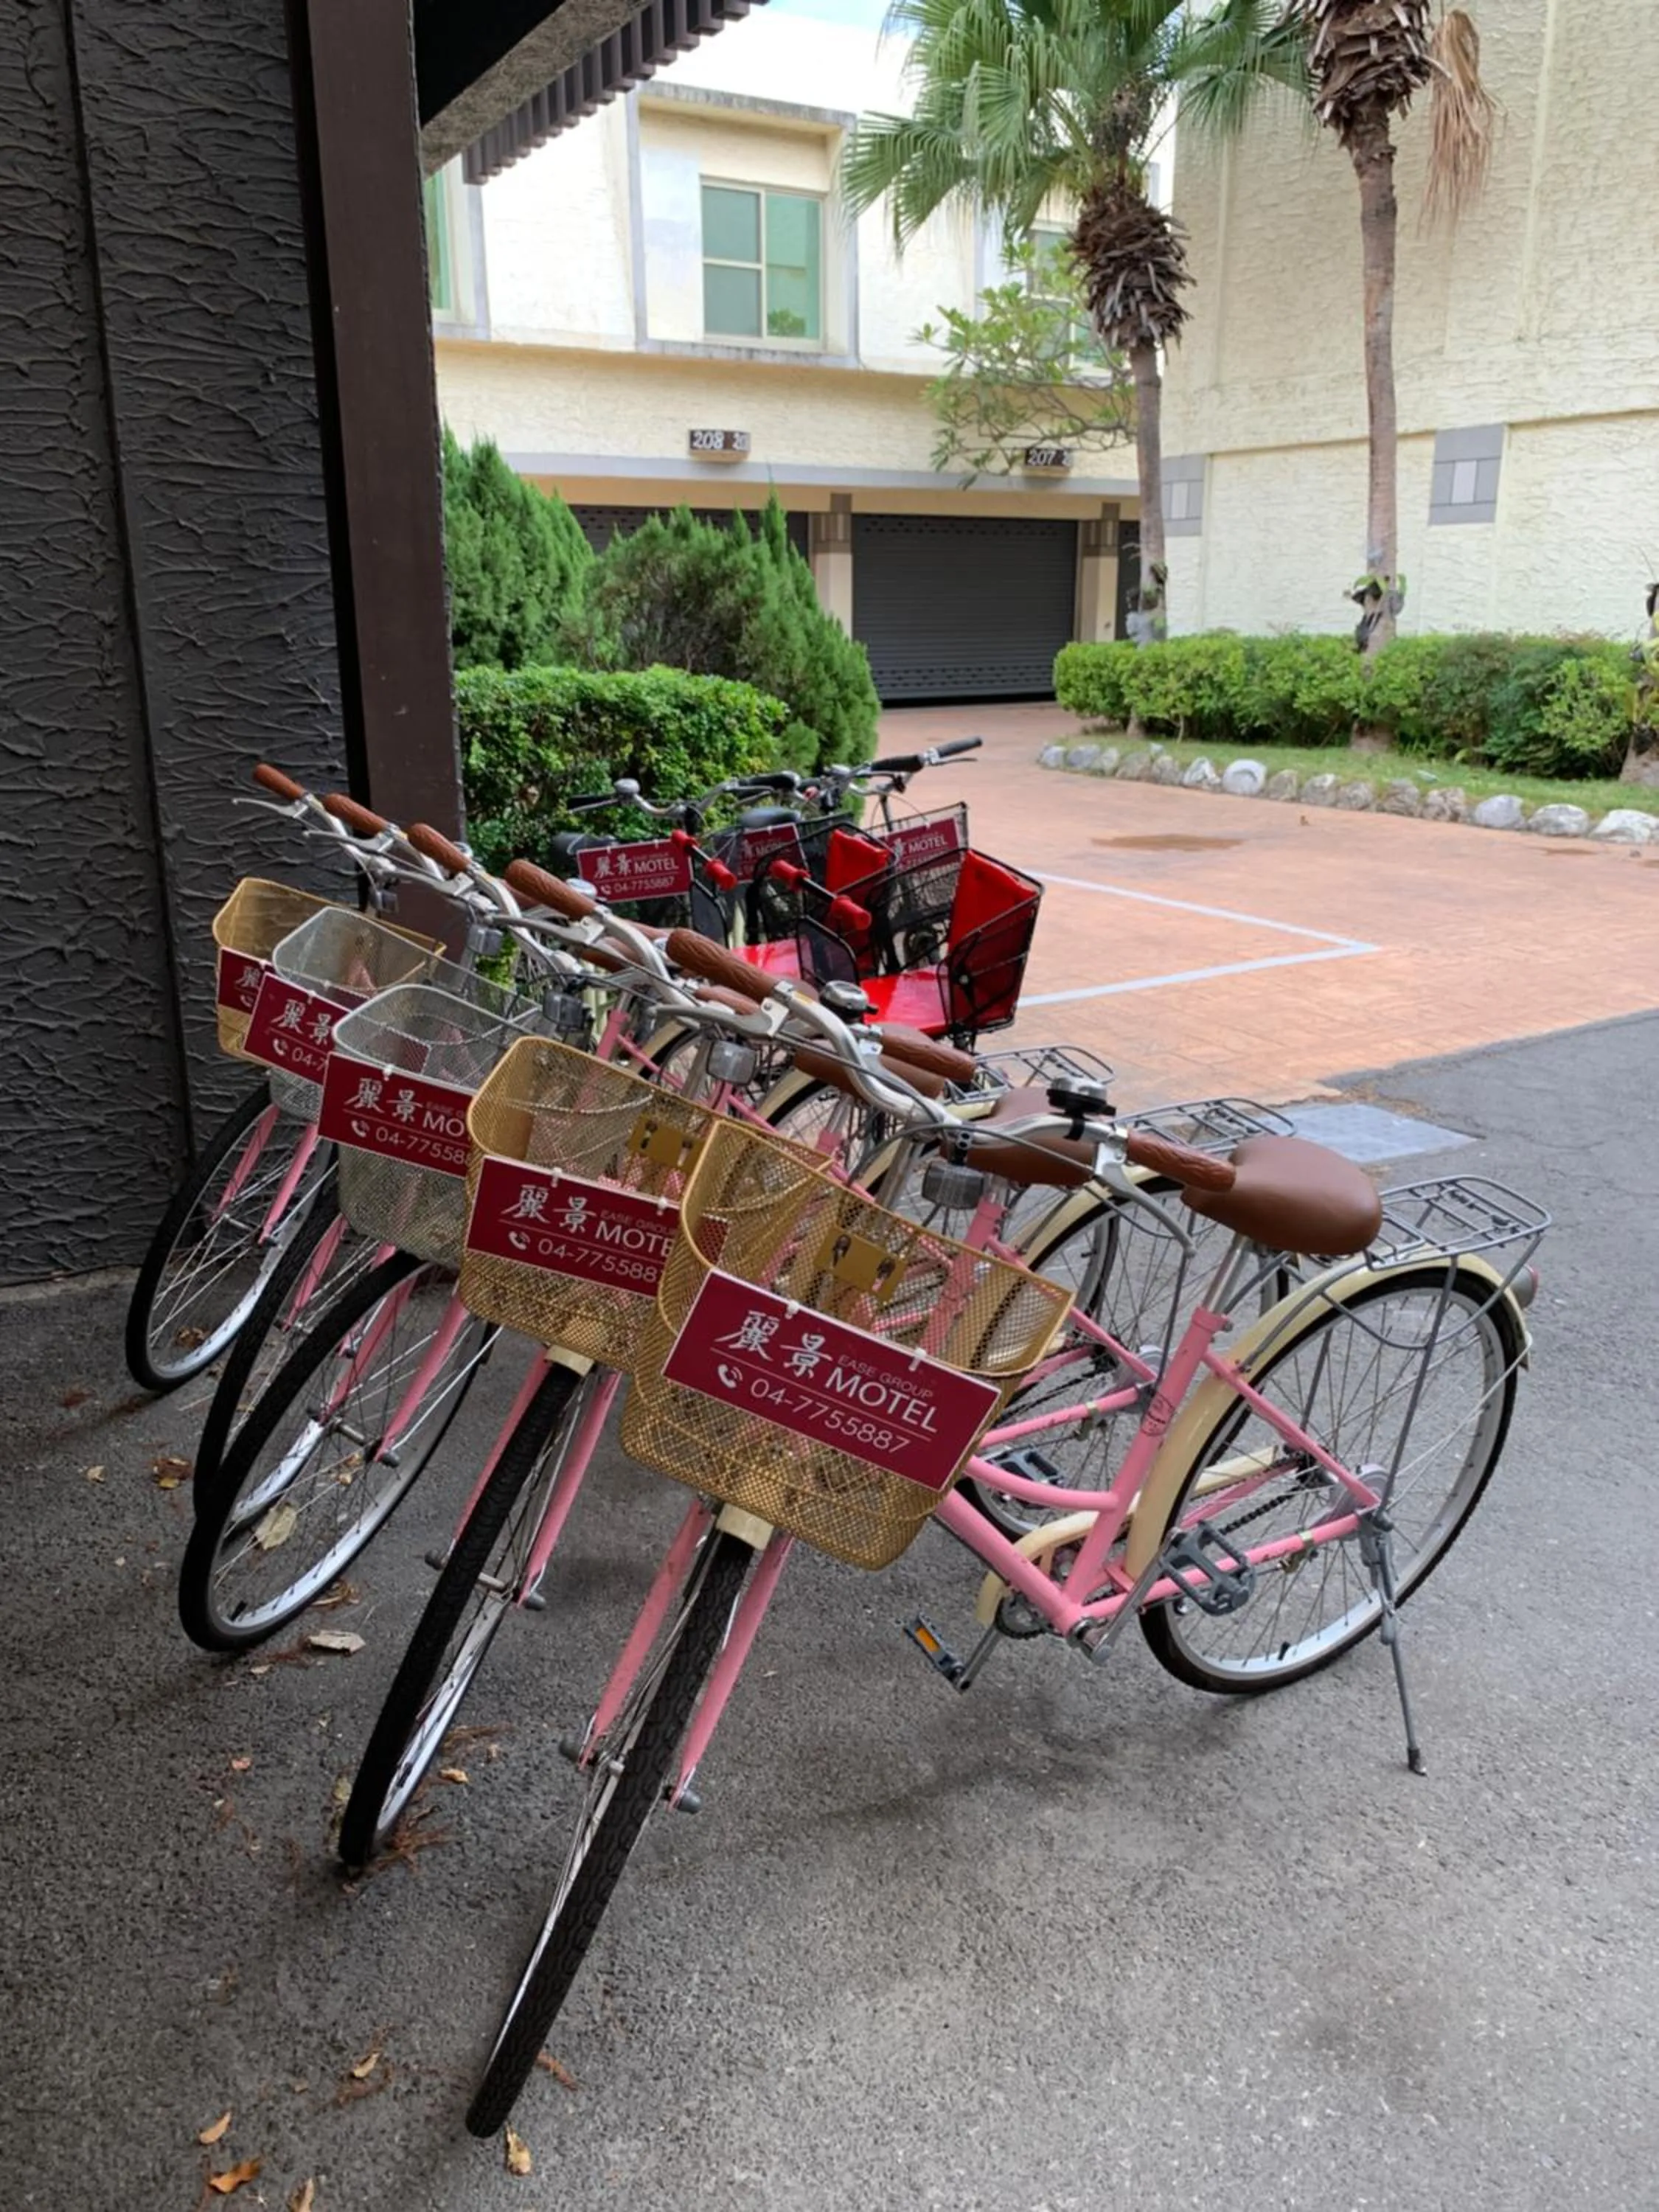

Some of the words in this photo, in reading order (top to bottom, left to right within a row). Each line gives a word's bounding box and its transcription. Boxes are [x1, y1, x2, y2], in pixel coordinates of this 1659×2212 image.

[693, 431, 723, 449] 208
[1027, 448, 1056, 465] 207
[908, 834, 948, 854] MOTEL
[633, 857, 679, 874] MOTEL
[291, 1046, 327, 1072] 04-7
[344, 1077, 423, 1123] 麗景
[422, 1110, 467, 1138] MO
[501, 1183, 597, 1234] 麗景
[595, 1220, 676, 1257] MOTE
[538, 1238, 662, 1283] 04-775588
[714, 1310, 833, 1379] 麗景
[838, 1354, 877, 1377] EASE
[879, 1372, 933, 1399] GROUP
[750, 1377, 911, 1454] 04-7755887
[825, 1366, 938, 1433] MOTEL
